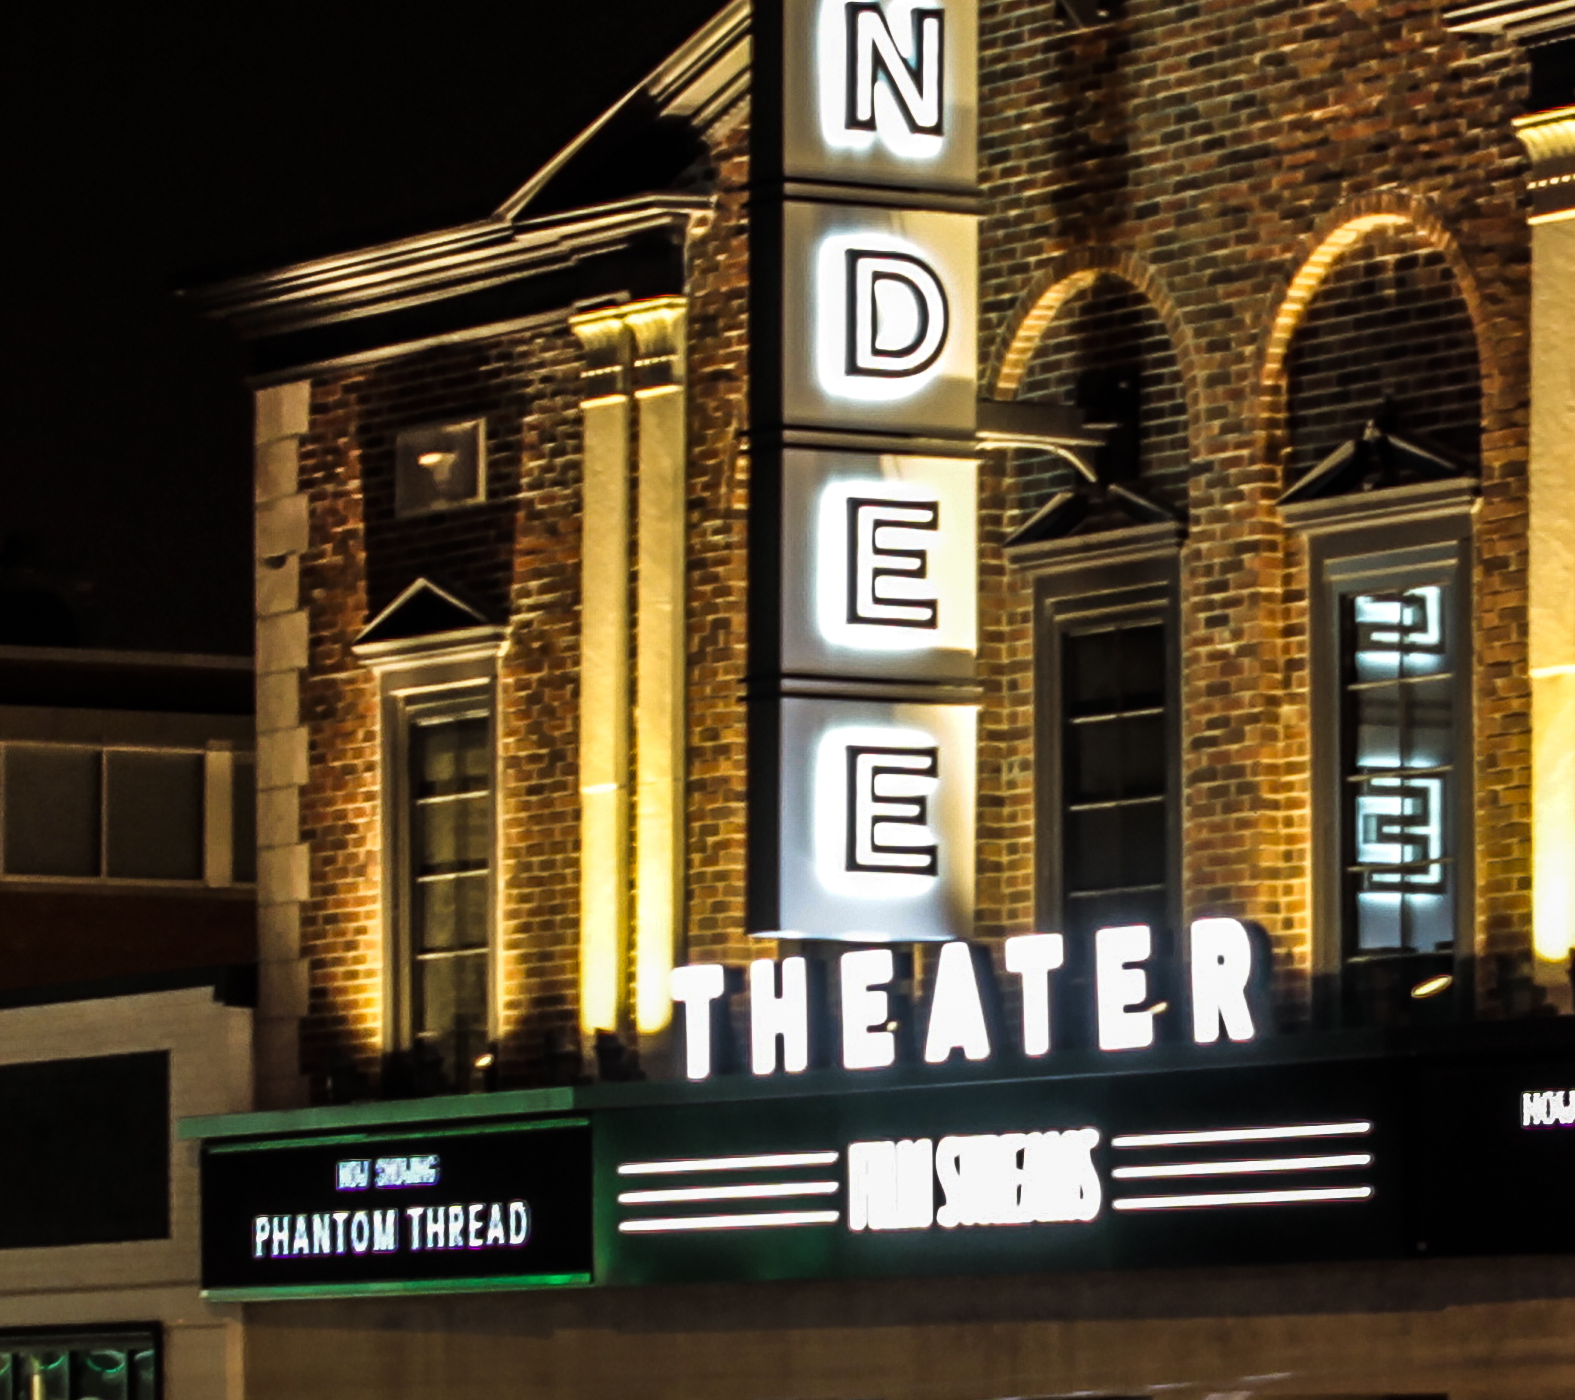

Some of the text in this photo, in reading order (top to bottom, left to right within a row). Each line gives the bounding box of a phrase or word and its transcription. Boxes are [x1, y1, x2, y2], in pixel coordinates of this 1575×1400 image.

[671, 917, 1256, 1081] THEATER
[253, 1199, 529, 1258] PHANTOM THREAD
